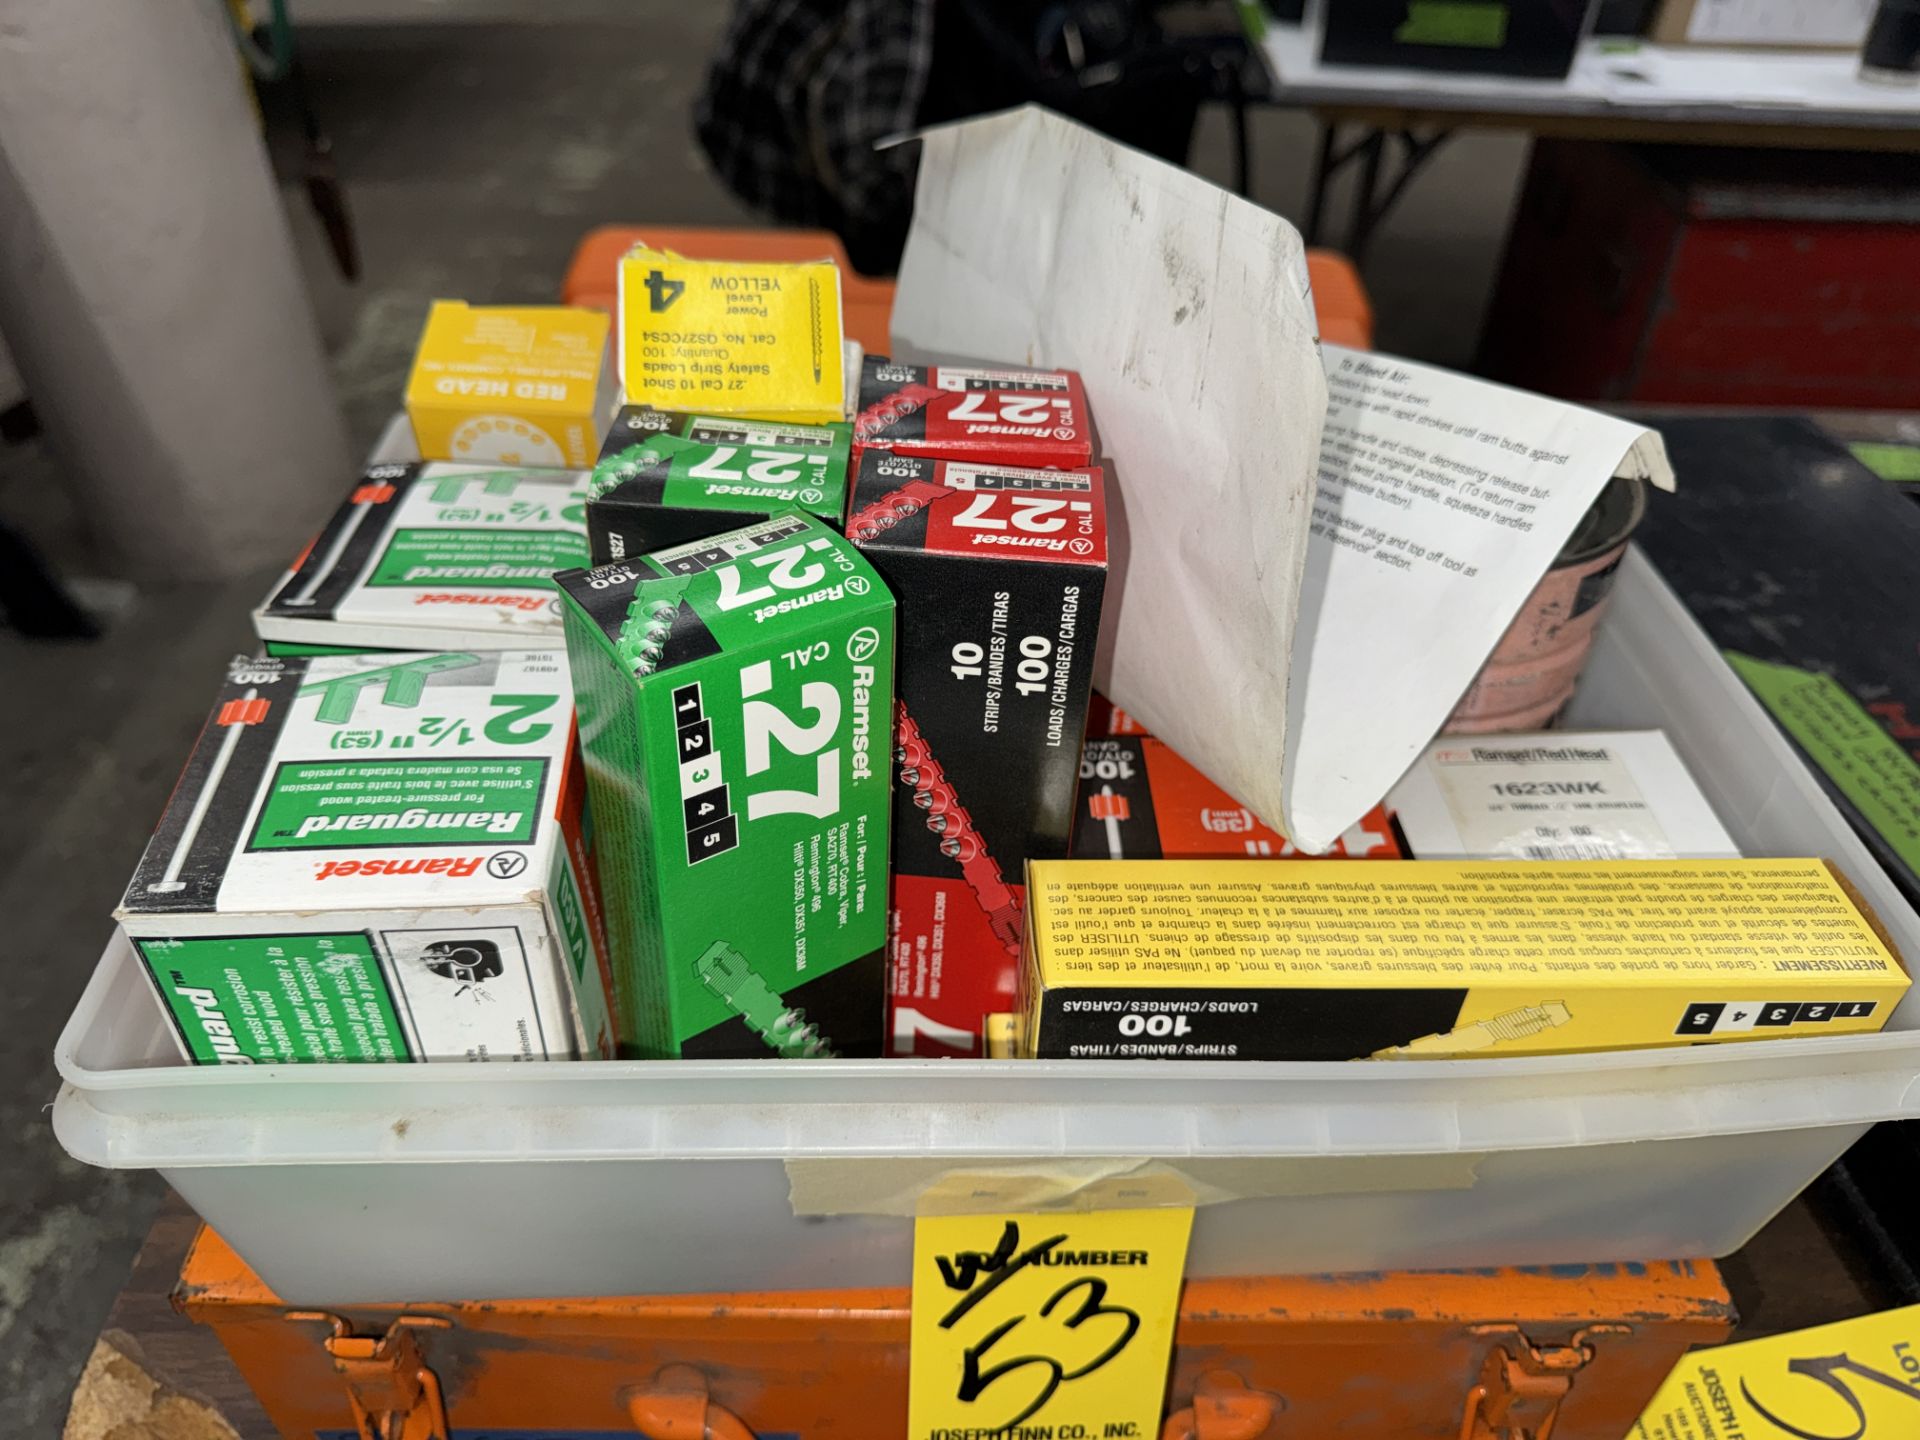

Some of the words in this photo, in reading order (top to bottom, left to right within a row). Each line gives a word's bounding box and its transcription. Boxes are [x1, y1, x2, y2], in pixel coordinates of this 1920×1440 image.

[710, 277, 781, 291] YELLOW
[644, 271, 685, 313] 4
[726, 294, 762, 305] Level
[726, 306, 768, 317] Power
[642, 331, 717, 345] QS27CCS4
[722, 334, 745, 344] No.
[749, 334, 776, 345] Cat.
[643, 347, 666, 358] 100
[671, 348, 729, 360] Quantity:
[643, 363, 685, 373] Loads
[691, 361, 722, 374] Strip
[728, 363, 770, 375] Safety
[435, 376, 510, 397] HEAD
[643, 379, 675, 390] Shot
[681, 379, 696, 389] 10
[701, 379, 723, 390] Cal
[728, 380, 747, 390] .27
[514, 382, 567, 401] RED
[947, 394, 1071, 423] .27
[1061, 409, 1073, 425] CAL
[627, 421, 671, 431] 100
[966, 425, 1052, 437] Ramset
[1417, 413, 1452, 433] strokes
[1454, 424, 1478, 440] until
[1478, 431, 1499, 444] ram
[1500, 437, 1528, 453] butts
[1529, 445, 1569, 465] against
[688, 447, 829, 483] .27
[811, 465, 827, 486] CAL
[877, 467, 921, 477] 100
[705, 484, 799, 501] Ramset
[952, 493, 1092, 533] .27
[1079, 513, 1092, 535] CAL
[971, 534, 1068, 551] Ramset
[828, 547, 855, 572] CAL
[678, 562, 691, 570] 5
[714, 536, 834, 612] .27
[589, 571, 640, 590] 100
[413, 593, 549, 611] Ramset
[754, 584, 844, 623] Ramset
[780, 641, 830, 671] CAL
[950, 642, 984, 681] 10
[984, 591, 1010, 733] STRIPS/BANDES/TIRAS
[1015, 635, 1052, 696] 100
[1047, 585, 1080, 747] LOADS/CHARGES/CARGAS
[229, 672, 283, 684] 100
[679, 698, 696, 712] 1
[484, 693, 560, 744] 2
[852, 665, 874, 780] Ramset
[685, 734, 704, 751] 2
[739, 660, 841, 822] .27
[299, 766, 345, 778] presión
[359, 767, 404, 777] tratada
[406, 766, 453, 776] madera
[455, 767, 479, 775] con
[481, 766, 505, 775] usa
[507, 767, 522, 777] Se
[692, 768, 710, 783] 3
[280, 781, 333, 793] pression
[335, 781, 365, 791] sous
[366, 781, 402, 792] traité
[405, 780, 432, 791] bois
[435, 780, 446, 790] le
[448, 779, 479, 789] avec
[481, 779, 533, 790] S'utilise
[1491, 782, 1607, 796] 1623WK
[320, 796, 353, 807] wood
[356, 793, 461, 806] pressure-treated
[463, 793, 485, 804] For
[698, 802, 715, 816] 4
[703, 832, 720, 847] 5
[827, 827, 837, 864] SA270,
[314, 856, 485, 880] Ramset
[794, 868, 805, 904] DX350,
[828, 866, 837, 896] RT400
[838, 867, 849, 900] Cobra,
[811, 895, 821, 913] 496
[838, 899, 849, 929] Viper,
[794, 904, 805, 939] DX351,
[316, 940, 334, 949] la
[266, 947, 284, 956] la
[796, 938, 806, 972] DX36M
[1065, 962, 1093, 972] tiers
[1097, 962, 1120, 972] des
[1125, 962, 1137, 972] et
[1142, 961, 1211, 972] l'utilisateur
[1215, 961, 1231, 972] de
[1235, 960, 1270, 972] mort,
[1274, 961, 1286, 972] la
[1290, 961, 1322, 972] voire
[1326, 959, 1372, 971] graves,
[1376, 961, 1438, 972] blessures
[1441, 961, 1464, 972] des
[1470, 961, 1503, 972] éviter
[1508, 961, 1538, 972] Pour
[1544, 961, 1590, 972] enfants.
[1594, 961, 1616, 972] des
[1620, 959, 1659, 972] portée
[1663, 961, 1679, 972] de
[1682, 961, 1712, 971] hors
[1715, 961, 1757, 971] Garder
[1772, 961, 1888, 971] AVERTISSEMENT
[294, 957, 327, 1000] pression
[224, 968, 257, 1015] corrosion
[277, 967, 305, 1006] résister
[252, 990, 279, 1017] wood
[1062, 1000, 1258, 1013] LOADS/CHARGES/CARGAS
[1848, 1004, 1861, 1015] 1
[313, 1002, 334, 1025] sous
[1732, 1011, 1748, 1022] 4
[1769, 1008, 1787, 1020] 3
[1808, 1006, 1827, 1017] 2
[295, 1008, 323, 1031] pour
[1692, 1013, 1710, 1024] 5
[243, 1017, 270, 1045] resist
[1118, 1014, 1192, 1037] 100
[259, 1046, 274, 1056] to
[957, 1276, 1141, 1432] 53
[1699, 1366, 1739, 1431] JOSEPH
[1058, 1423, 1097, 1439] CO.,
[1103, 1422, 1141, 1437] INC.
